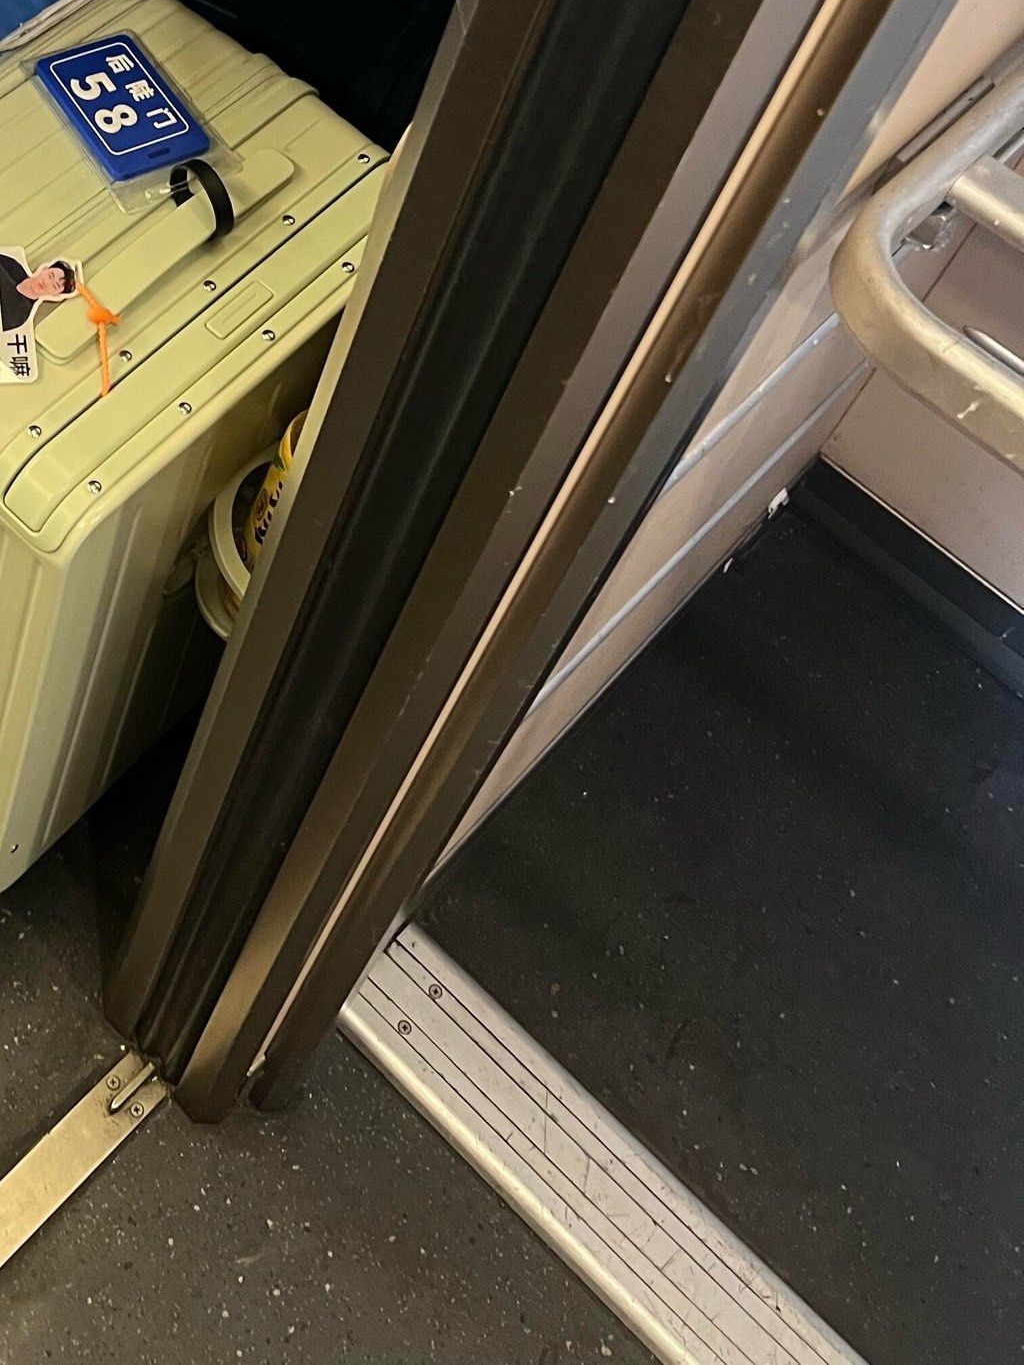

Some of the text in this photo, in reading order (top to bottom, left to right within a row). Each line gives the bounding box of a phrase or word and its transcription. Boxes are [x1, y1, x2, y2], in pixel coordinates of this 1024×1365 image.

[69, 71, 138, 134] 58
[105, 53, 178, 130] 后陡门
[7, 333, 31, 378] 干嘛
